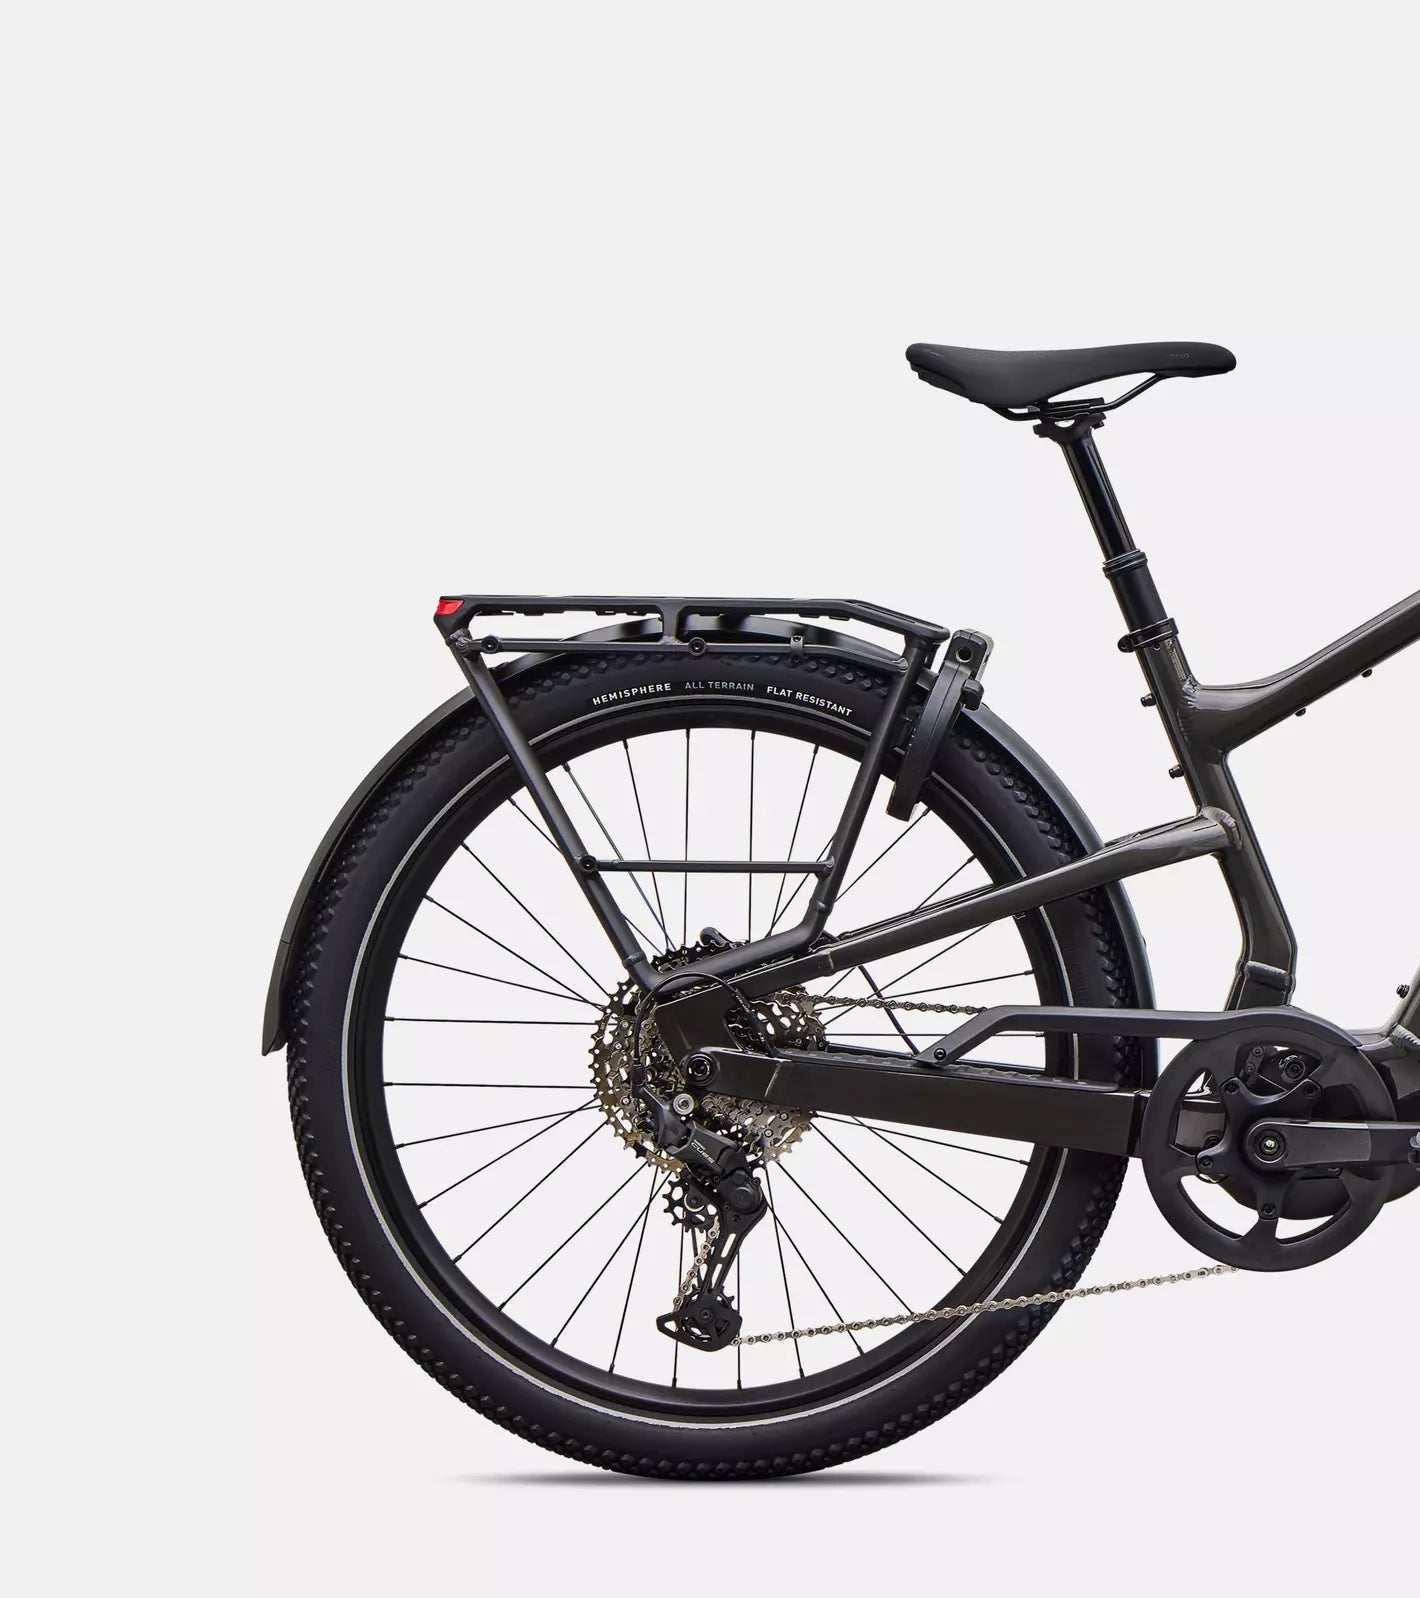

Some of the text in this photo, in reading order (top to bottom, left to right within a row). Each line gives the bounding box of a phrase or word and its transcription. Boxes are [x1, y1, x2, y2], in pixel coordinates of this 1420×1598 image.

[592, 682, 672, 706] HEMISPHERE
[684, 681, 754, 691] ALL TERRAIN
[766, 685, 853, 717] FLAT RESISTANT
